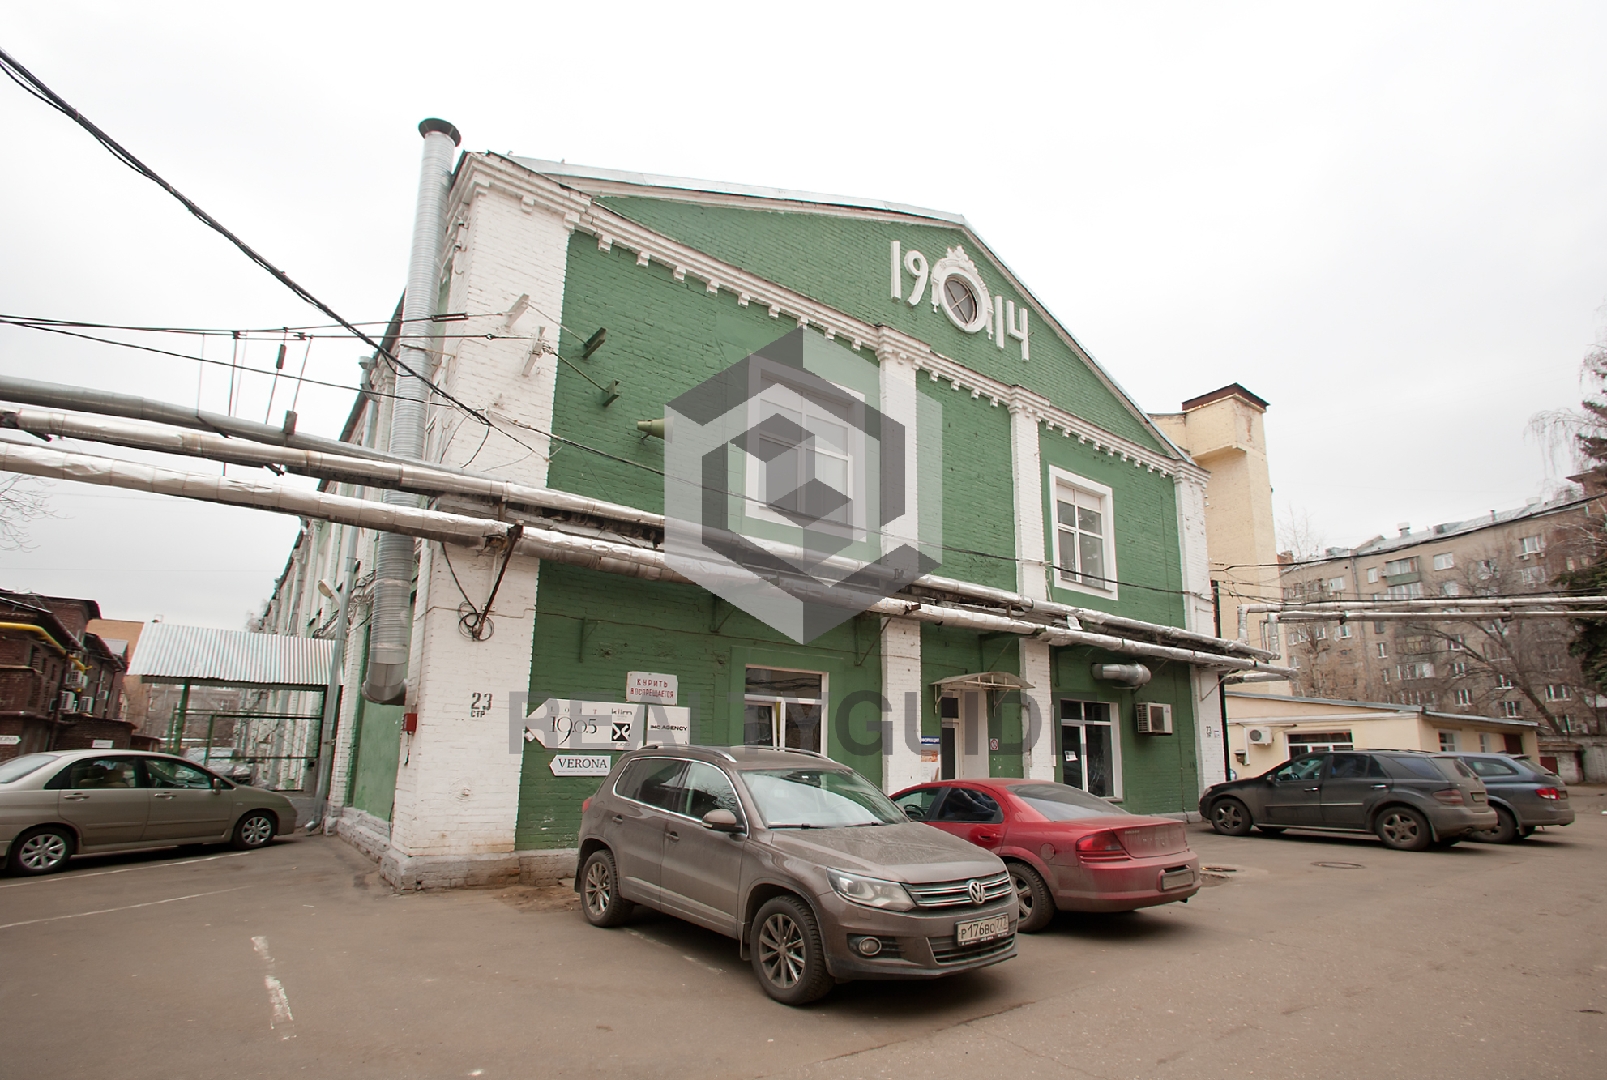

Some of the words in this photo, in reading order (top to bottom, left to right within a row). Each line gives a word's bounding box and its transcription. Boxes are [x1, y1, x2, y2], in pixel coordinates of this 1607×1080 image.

[636, 678, 669, 688] КУРИТЬ
[629, 687, 675, 699] ВОСПРЕЩАЕТСЯ
[470, 692, 493, 711] 23
[470, 710, 486, 718] СТР
[558, 758, 608, 769] VERONA
